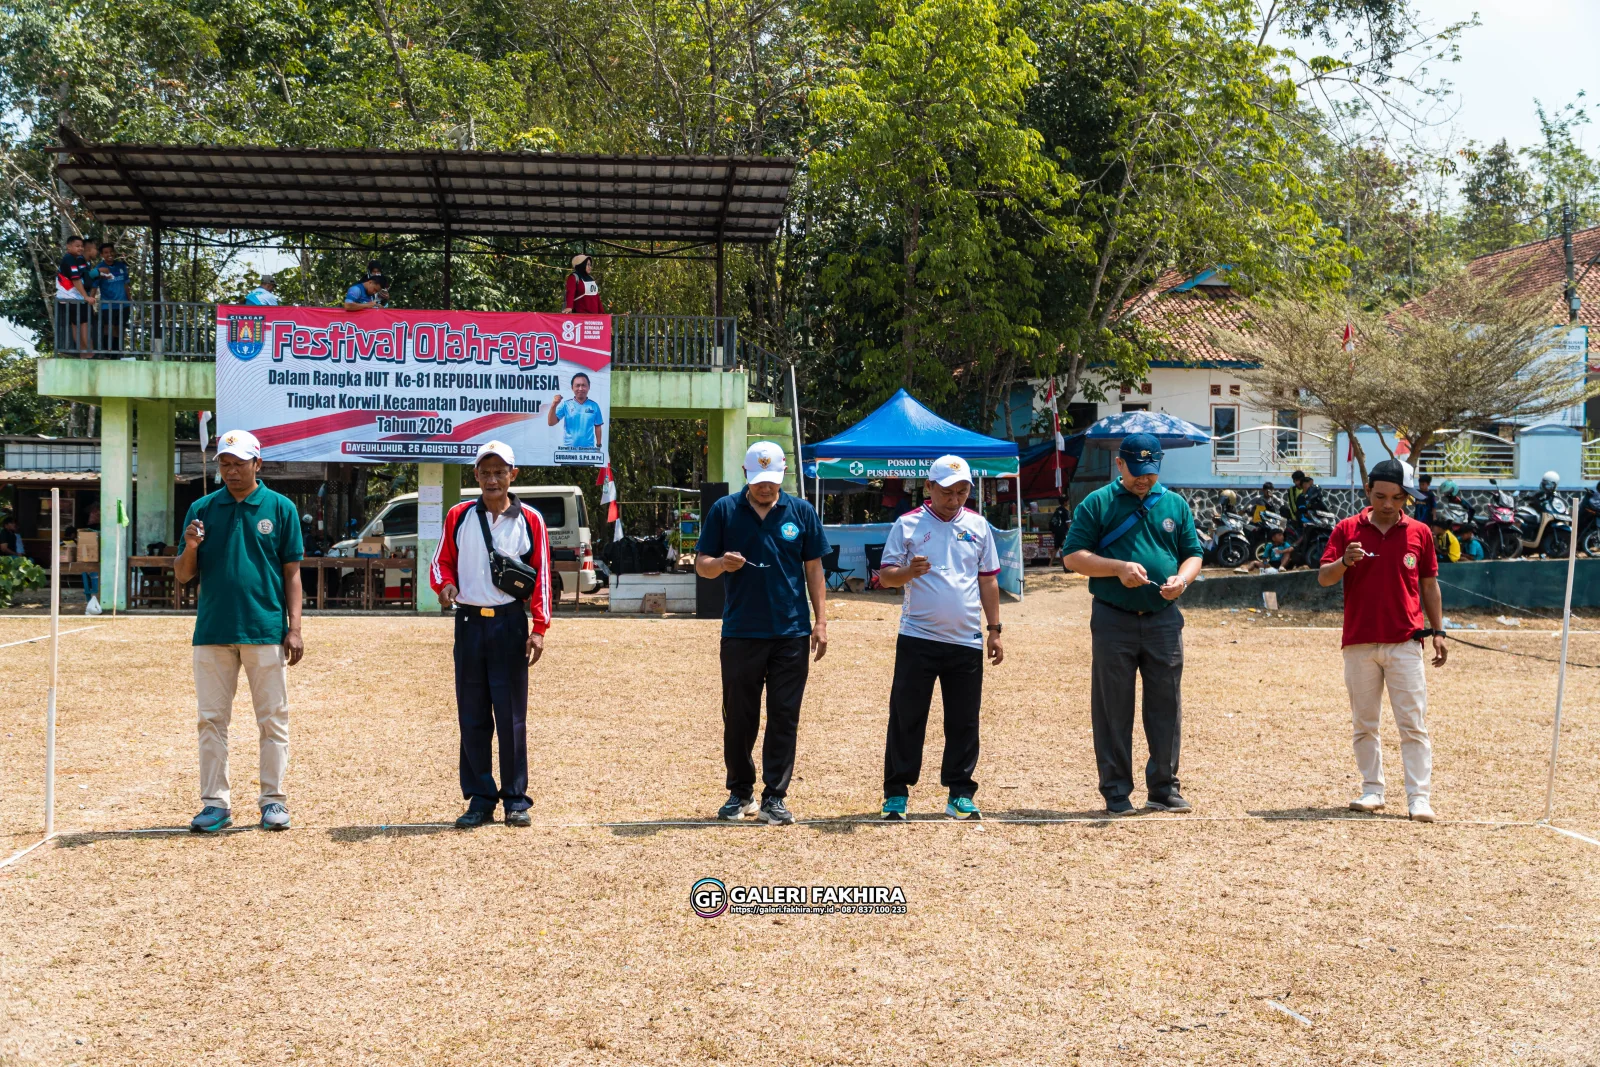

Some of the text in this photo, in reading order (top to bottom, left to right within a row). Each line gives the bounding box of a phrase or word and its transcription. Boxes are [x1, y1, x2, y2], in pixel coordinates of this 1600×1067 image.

[562, 320, 583, 345] 81
[272, 321, 559, 371] Festival Olahraga
[268, 369, 560, 391] Dalam Rangka HUT Ke-81 REPUBLIK INDONESIA
[287, 393, 542, 414] Tingkat Korwil Kecamatan Dayeuhluhur
[376, 417, 453, 434] Tahun 2026
[345, 442, 406, 453] DAYEUHLUHUR,
[408, 444, 420, 453] 26
[421, 444, 458, 453] AGUSTUS
[887, 459, 917, 467] POSKO
[866, 469, 916, 477] PUSKESMAS
